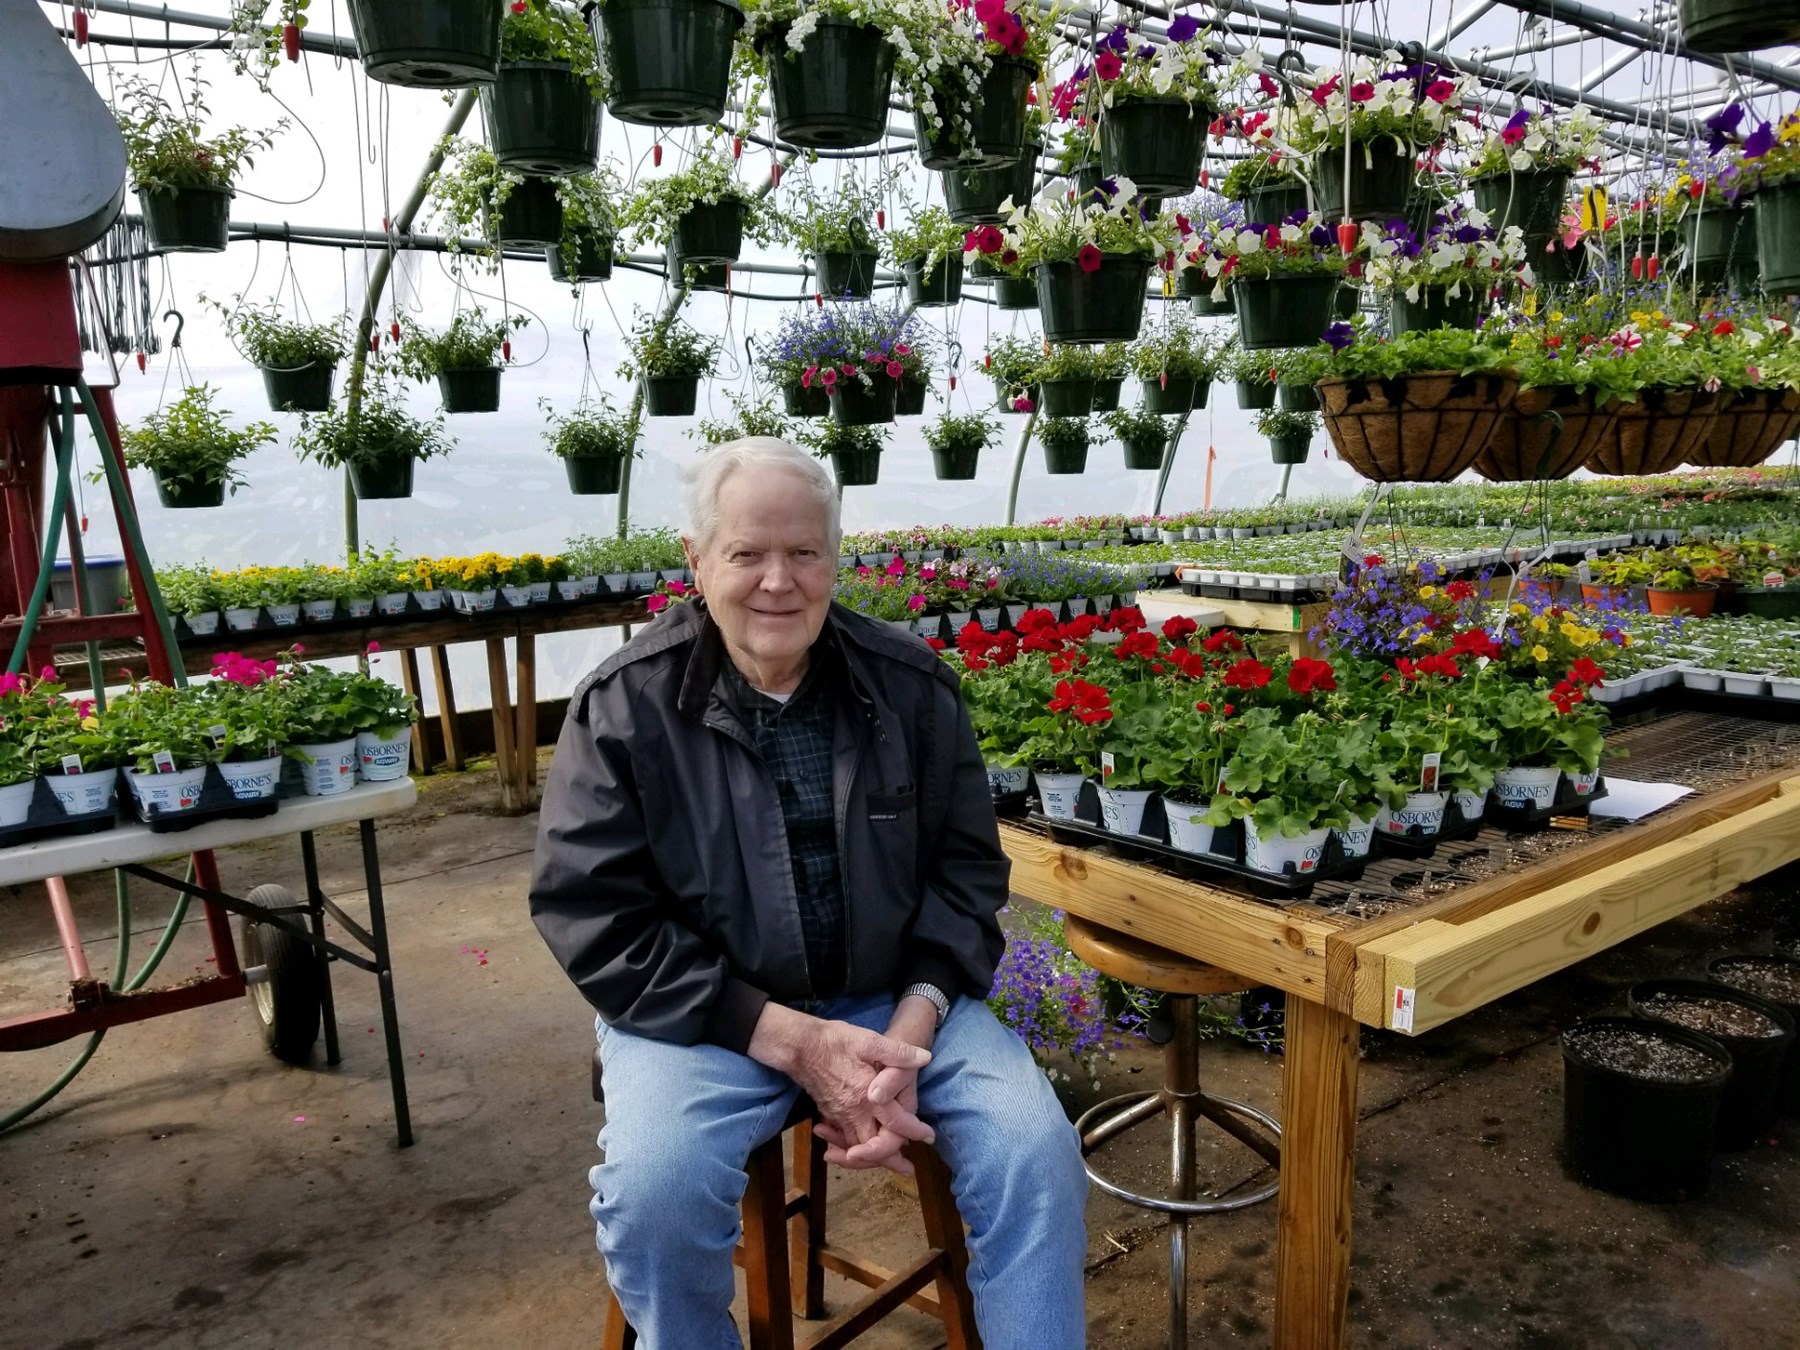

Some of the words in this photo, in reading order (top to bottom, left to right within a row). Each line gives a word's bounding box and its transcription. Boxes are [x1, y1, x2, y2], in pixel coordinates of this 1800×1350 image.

[362, 742, 407, 757] OSBORNE'S
[226, 774, 272, 789] SBORNE'S
[988, 769, 1021, 783] ORNE'S
[1504, 801, 1524, 809] AGW
